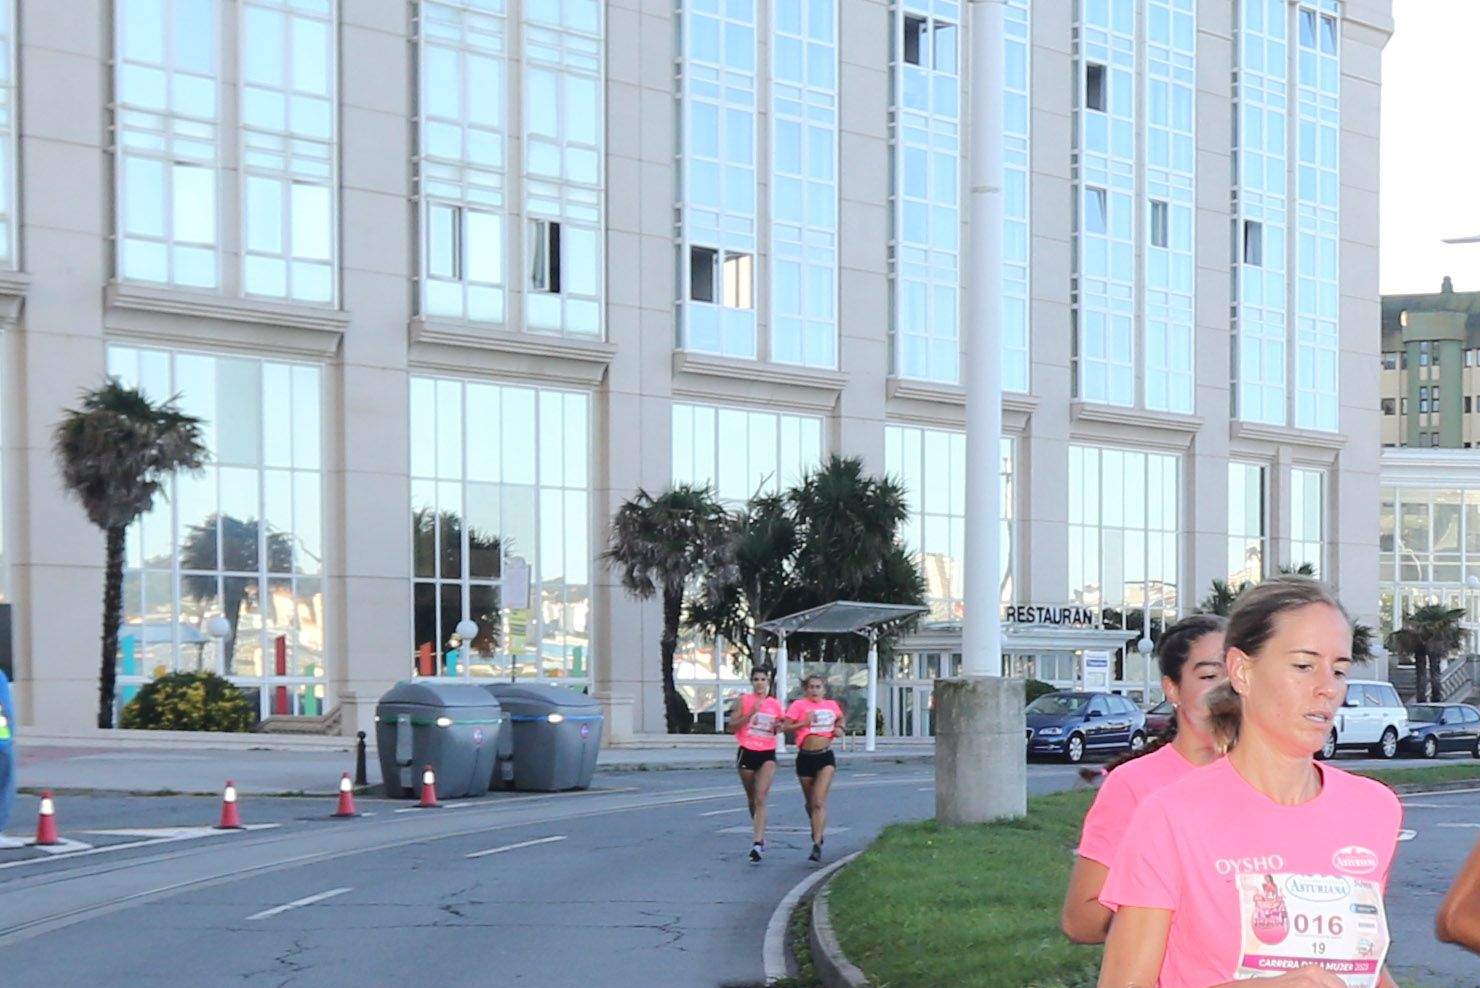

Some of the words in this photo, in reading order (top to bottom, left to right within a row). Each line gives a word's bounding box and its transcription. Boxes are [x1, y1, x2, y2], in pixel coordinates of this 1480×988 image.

[1216, 854, 1284, 875] OYSHO
[1294, 914, 1343, 935] 016
[1312, 942, 1326, 955] 19
[1259, 959, 1299, 969] CARRERA
